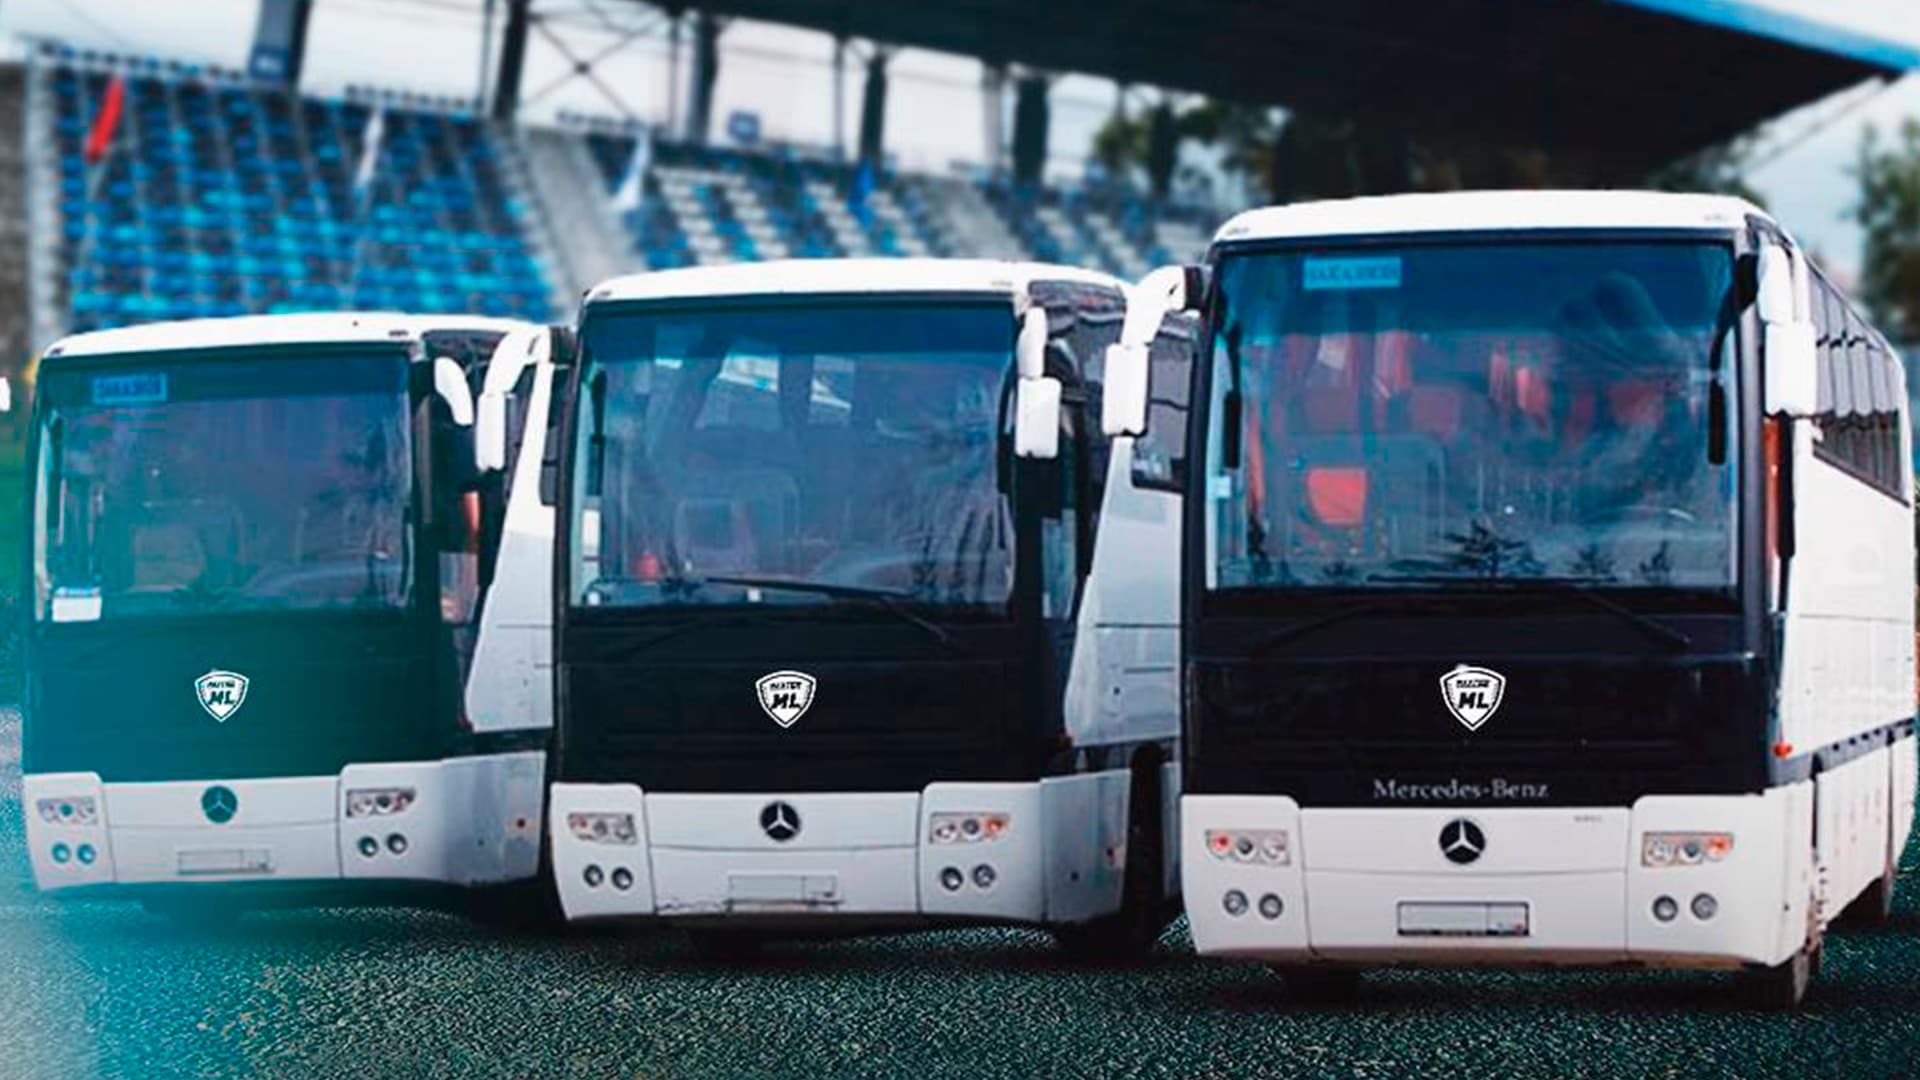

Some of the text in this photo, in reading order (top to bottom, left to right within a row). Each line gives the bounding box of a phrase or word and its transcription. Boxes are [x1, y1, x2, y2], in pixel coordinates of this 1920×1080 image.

[770, 693, 801, 709] ML
[1458, 692, 1490, 709] ML
[1373, 778, 1549, 799] Mercedes-Benz
